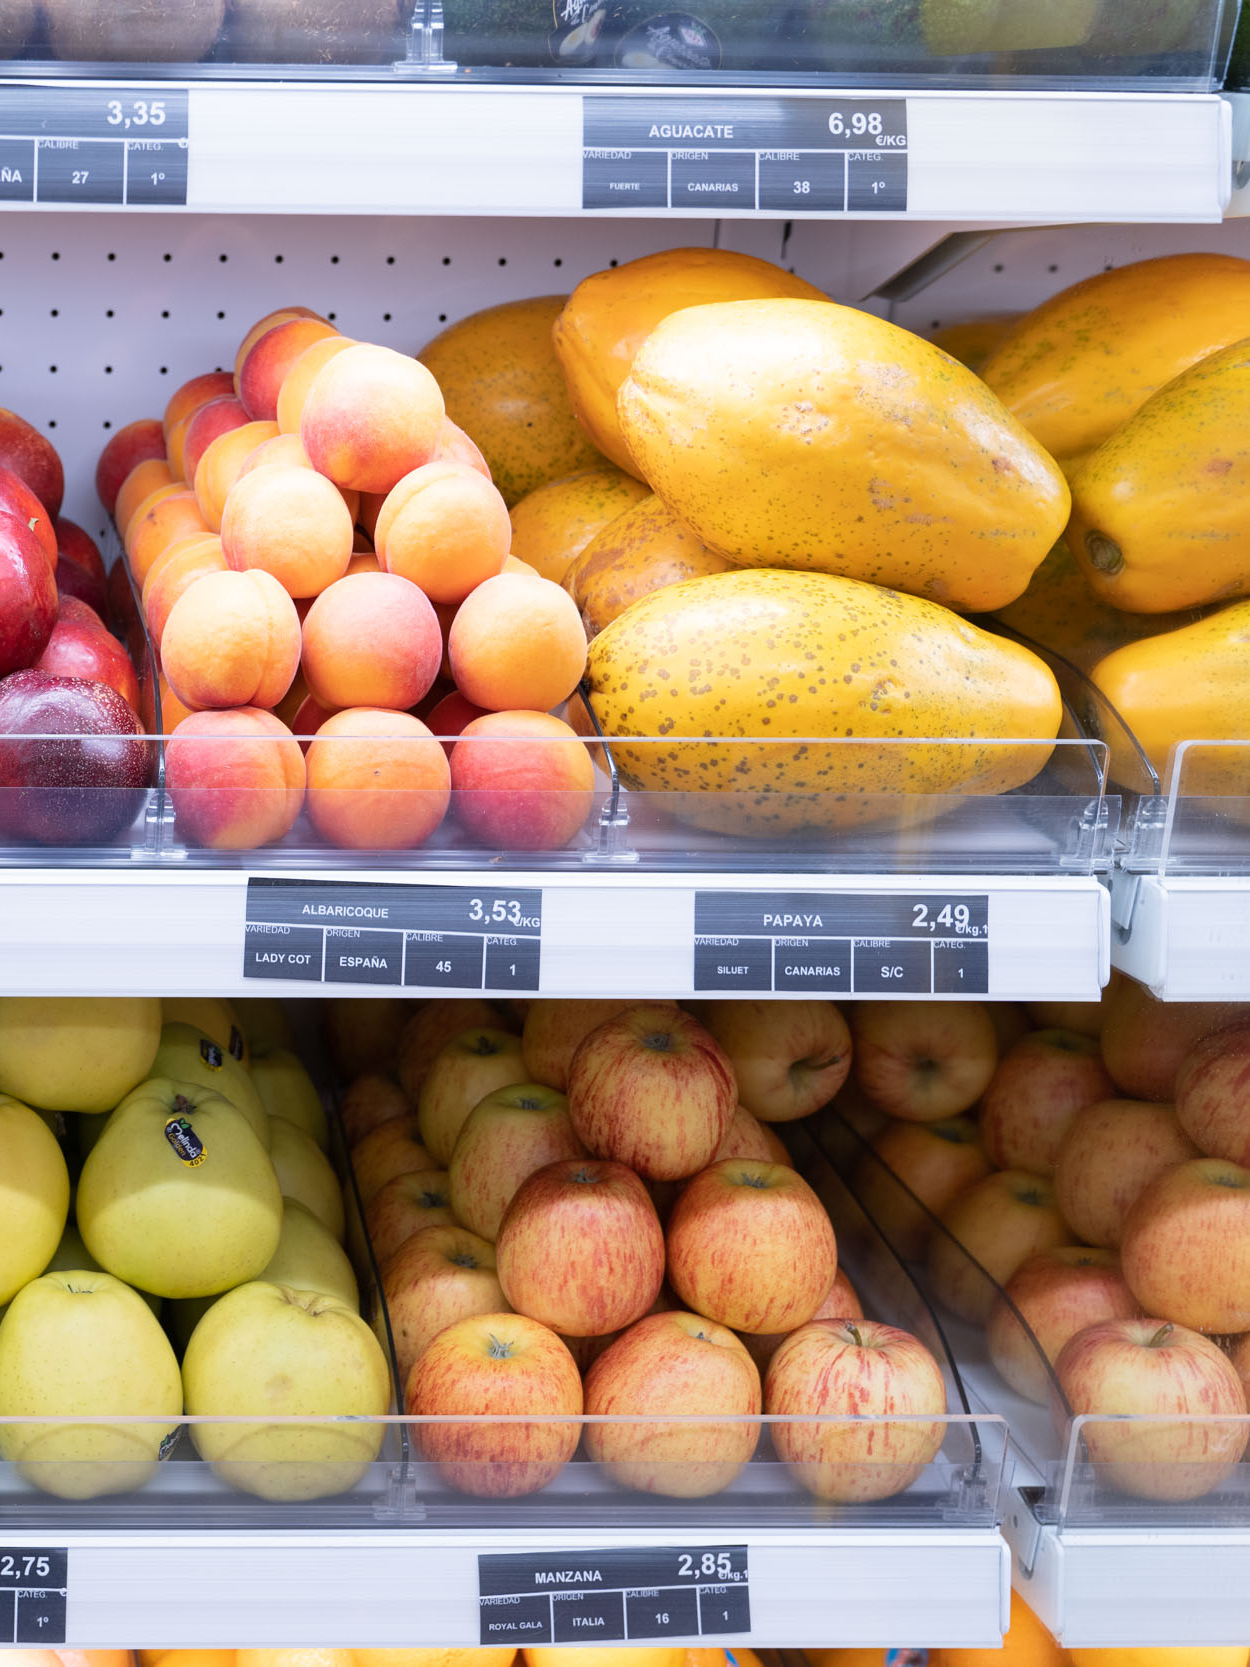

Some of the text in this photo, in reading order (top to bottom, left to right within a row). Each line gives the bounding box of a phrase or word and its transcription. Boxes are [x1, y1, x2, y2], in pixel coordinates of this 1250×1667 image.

[107, 100, 166, 129] 3,35
[828, 112, 883, 139] 6,98
[649, 125, 733, 138] AGUACATE
[38, 140, 78, 149] CALIBRE
[875, 135, 907, 146] €/KG
[583, 151, 631, 160] VARIEDAD
[670, 151, 708, 160] ORIGEN
[758, 152, 800, 161] CALIBRE
[72, 171, 89, 184] 27
[610, 183, 640, 191] FUERTE
[687, 183, 738, 192] CANARIAS
[793, 181, 810, 194] 38
[302, 904, 389, 918] ALBARICOQUE
[469, 898, 521, 925] 3,53
[763, 914, 823, 927] PAPAYA
[912, 904, 970, 932] 2,49
[245, 925, 290, 935] VARIEDAD
[325, 928, 360, 938] ORIGEN
[406, 932, 443, 942] CALIBRE
[694, 937, 739, 946] VARIEDAD
[774, 938, 808, 947] ORIGEN
[854, 939, 891, 948] CALIBRE
[255, 953, 311, 965] LADY COT
[340, 955, 387, 969] ESPAÑA
[436, 961, 452, 972] 45
[509, 965, 516, 975] 1
[717, 966, 749, 975] SILUET
[785, 966, 840, 976] CANARIAS
[881, 966, 904, 978] S/C
[958, 968, 964, 978] 1
[0, 1556, 50, 1579] 2,75
[678, 1552, 731, 1579] 2,85
[535, 1570, 602, 1584] MANZANA
[625, 1589, 659, 1598] CALIBRE
[479, 1596, 520, 1606] VARIEDAD
[655, 1613, 669, 1624] 16
[722, 1611, 728, 1621] 1
[489, 1621, 542, 1631] ROYAL GALA
[573, 1617, 605, 1627] ITALIA
